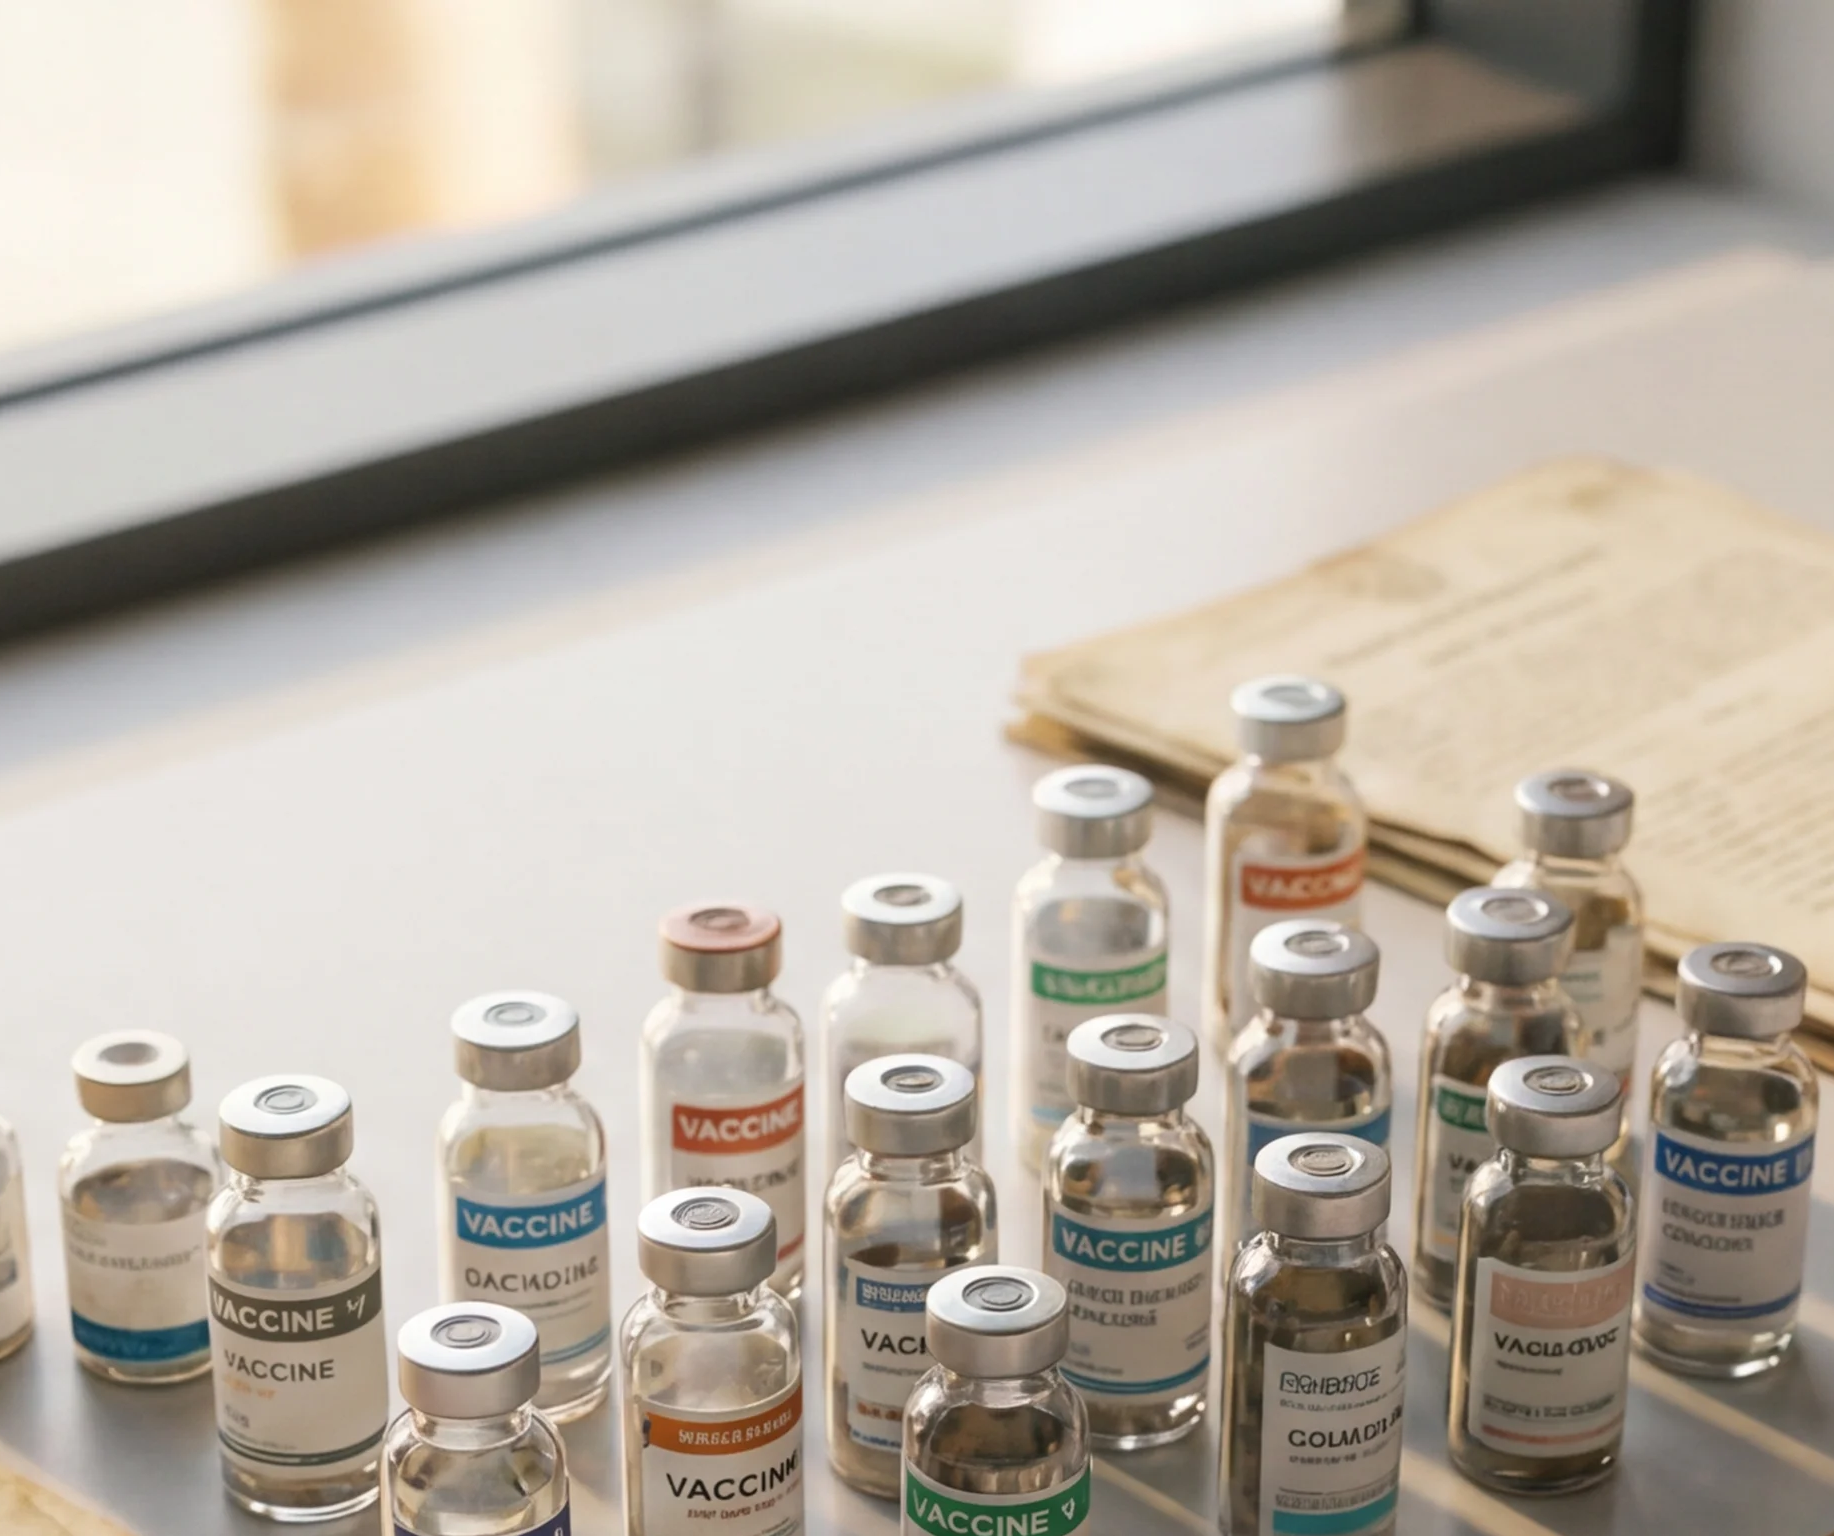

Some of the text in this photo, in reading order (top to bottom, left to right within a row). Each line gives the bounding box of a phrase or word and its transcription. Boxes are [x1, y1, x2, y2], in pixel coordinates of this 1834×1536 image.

[1665, 1147, 1789, 1188] VACCINE
[462, 1200, 594, 1240] VACCINE
[1061, 1227, 1187, 1264] VACCINE
[213, 1290, 335, 1333] VACCINE
[224, 1348, 336, 1383] VACCINE
